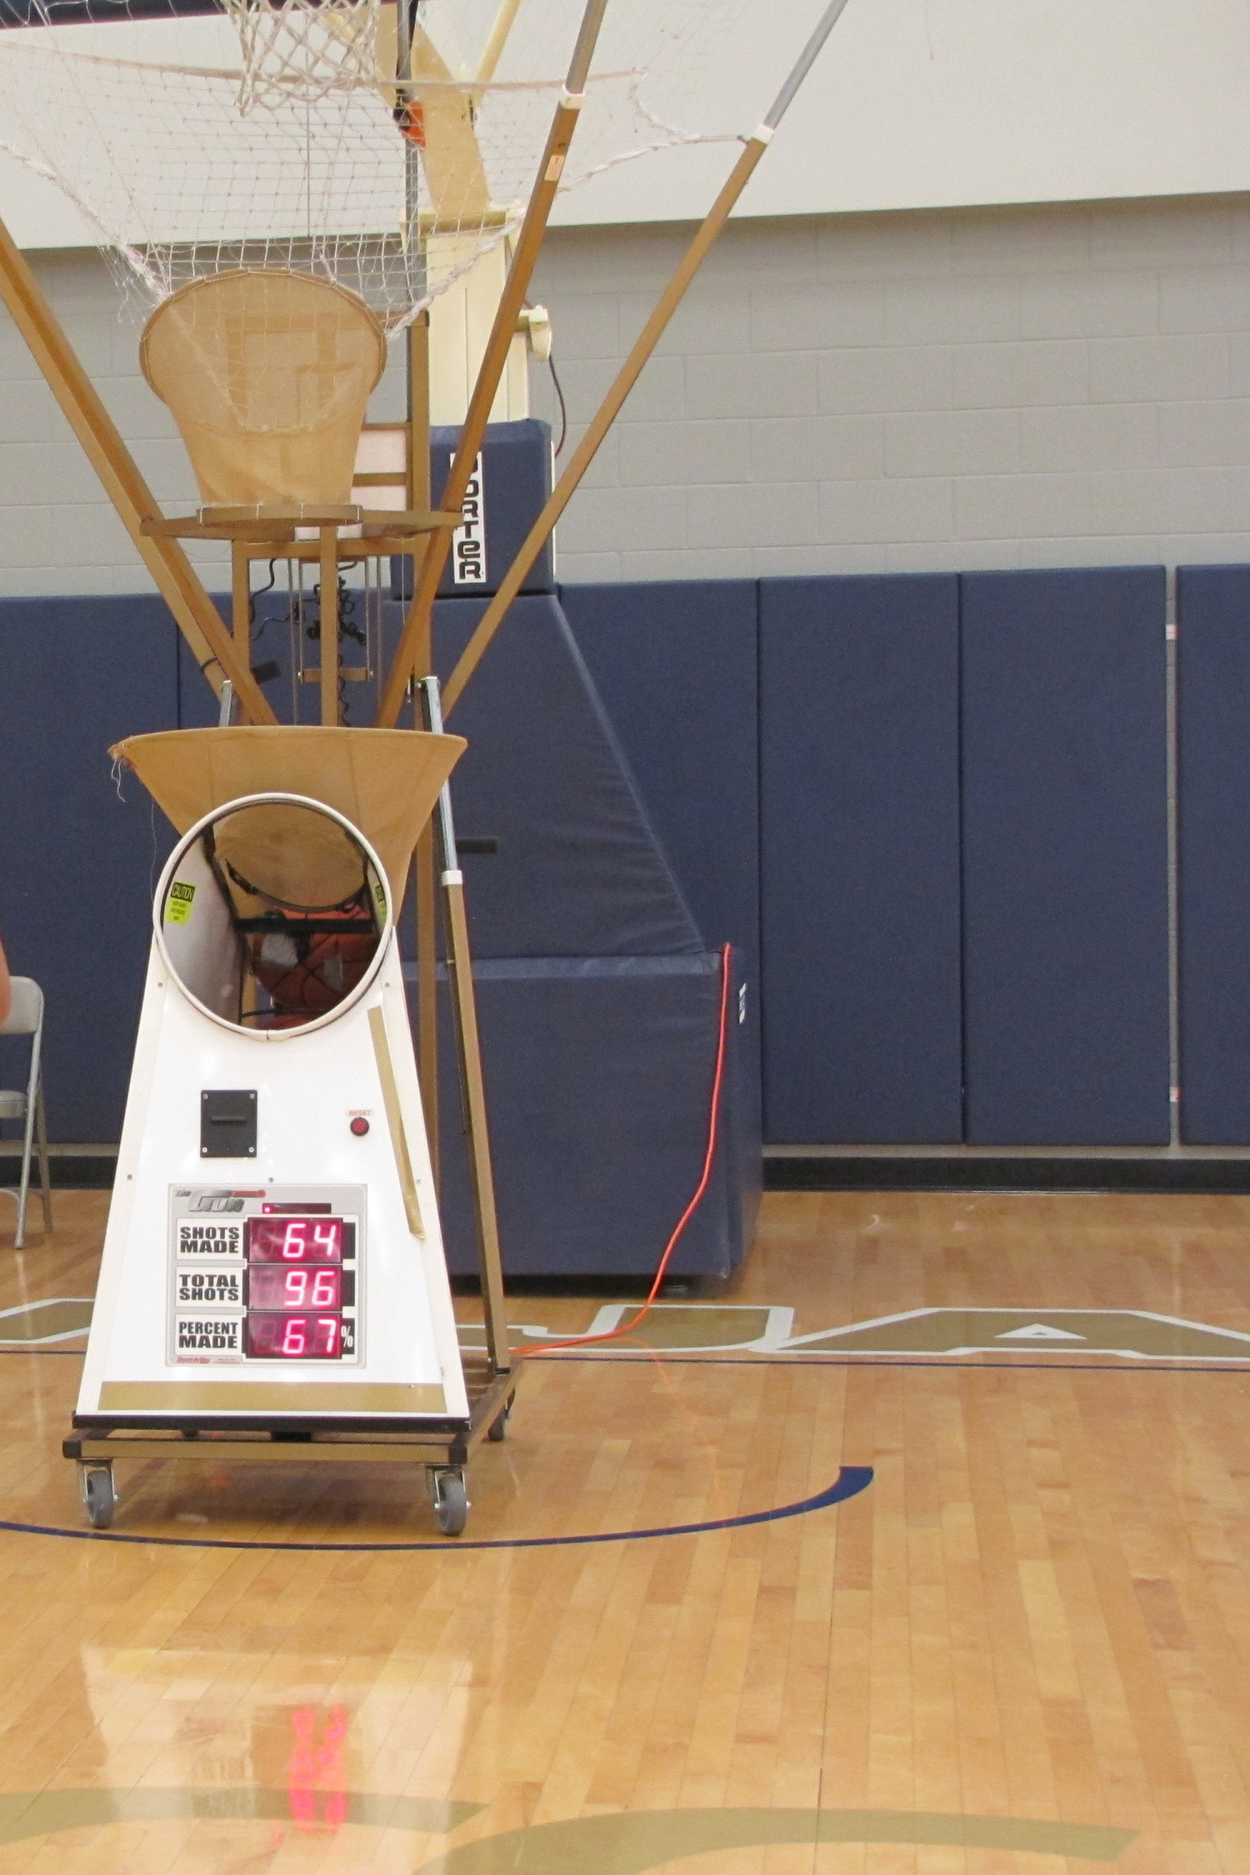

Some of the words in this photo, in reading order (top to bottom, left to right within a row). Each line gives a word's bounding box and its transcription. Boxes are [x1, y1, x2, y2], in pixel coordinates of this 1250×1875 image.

[349, 1109, 371, 1117] RESET
[180, 1227, 240, 1240] SHOTS
[180, 1240, 239, 1253] MADE
[282, 1222, 337, 1259] 64
[179, 1274, 239, 1288] TOTAL
[179, 1288, 239, 1301] SHOTS
[283, 1270, 336, 1307] 96
[178, 1322, 238, 1335] PERCENT
[178, 1335, 238, 1349] MADE
[282, 1318, 337, 1355] 67
[341, 1325, 353, 1348] %
